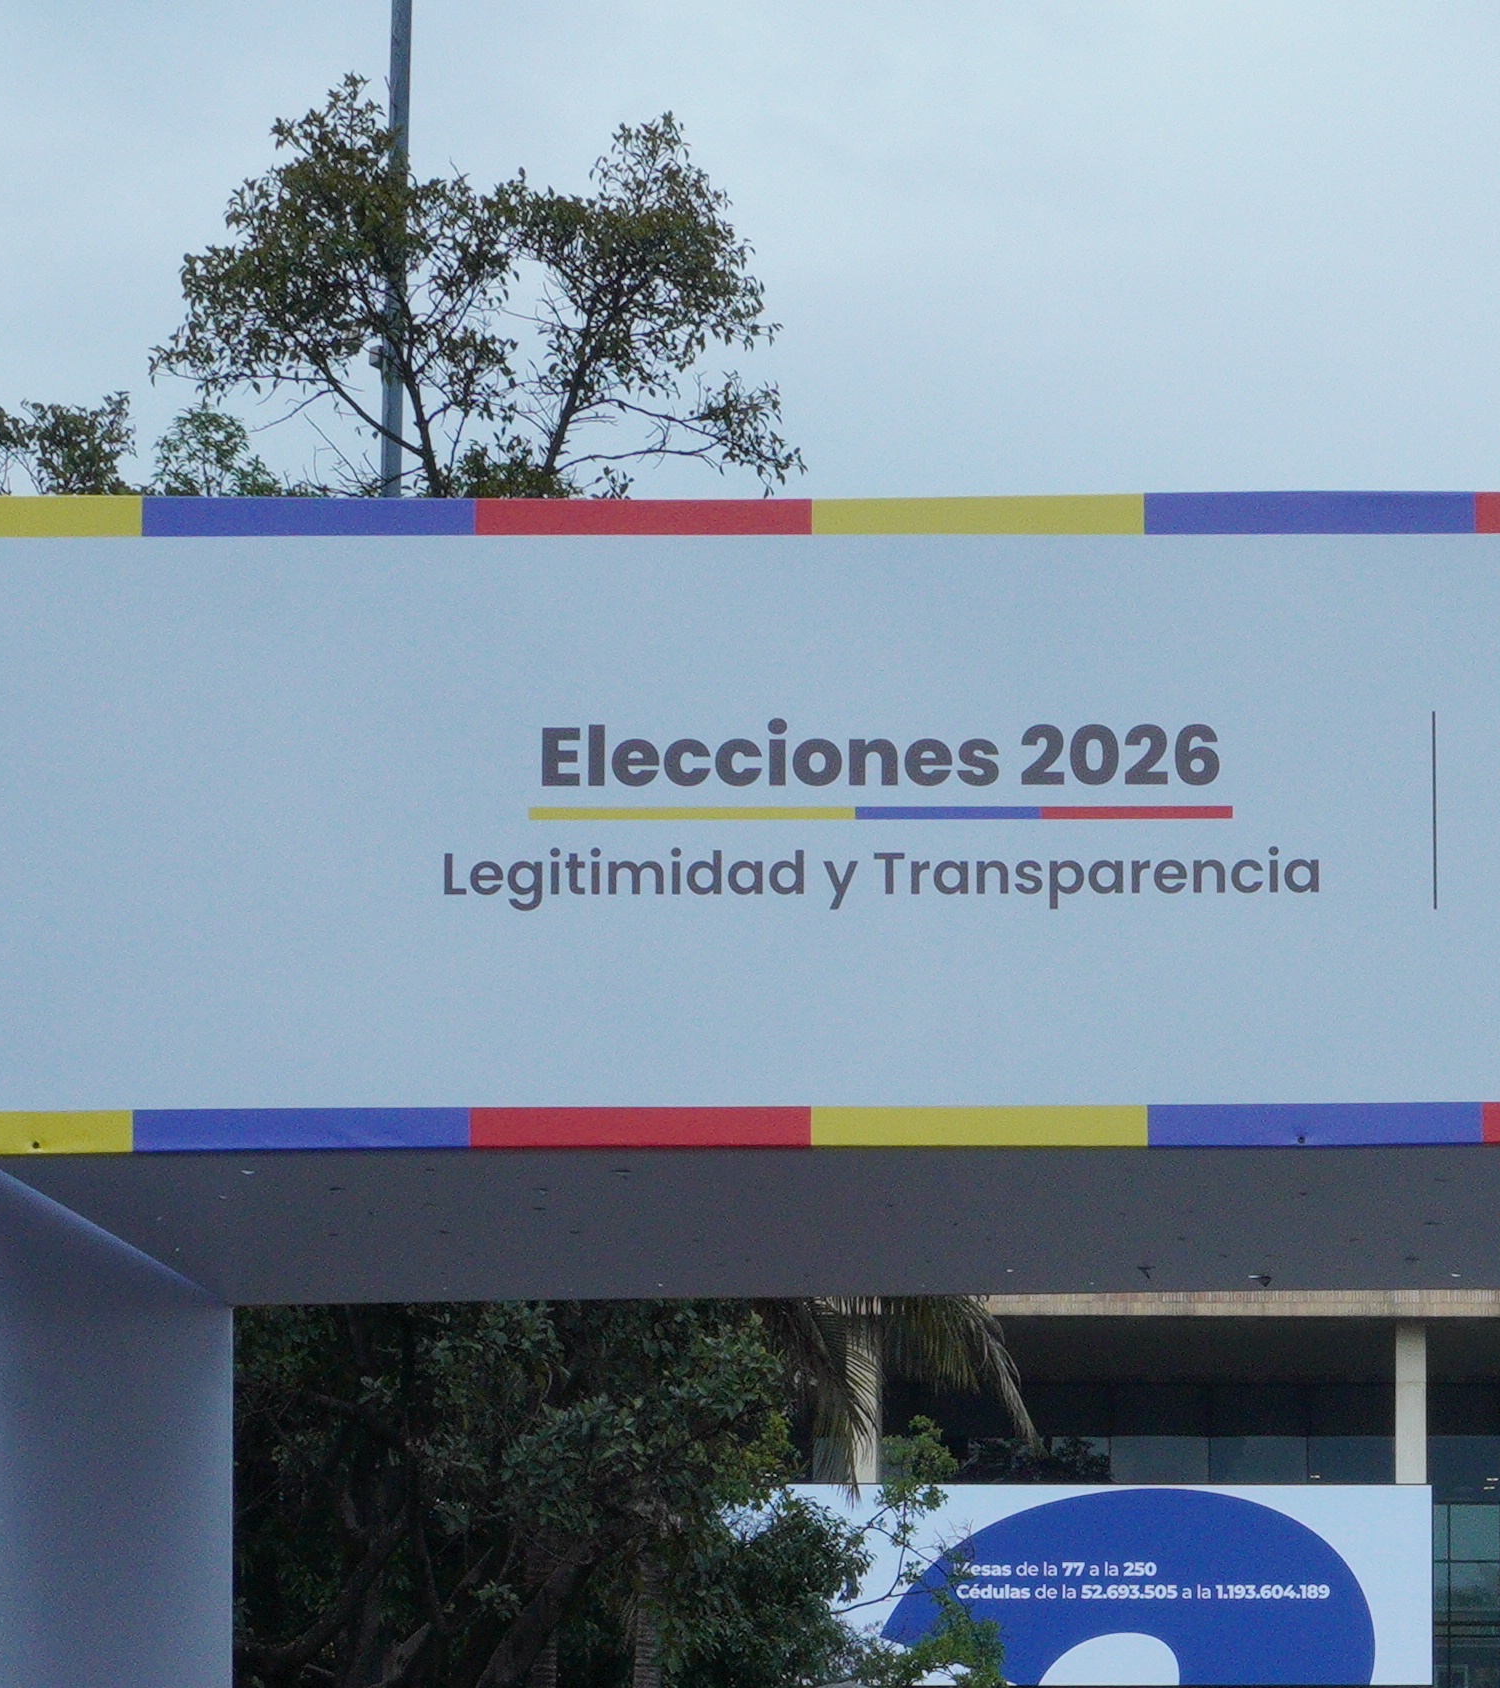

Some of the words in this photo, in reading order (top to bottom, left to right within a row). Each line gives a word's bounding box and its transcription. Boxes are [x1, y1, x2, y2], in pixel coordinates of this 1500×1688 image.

[541, 718, 1000, 788] Elecciones
[1021, 723, 1222, 787] 2026
[443, 848, 807, 911] Legitimidad
[824, 861, 858, 911] y
[874, 846, 1320, 911] Transparencia
[1015, 1561, 1040, 1577] de
[1043, 1561, 1058, 1577] la
[1062, 1562, 1084, 1577] 77
[1089, 1565, 1099, 1577] a
[1104, 1561, 1119, 1577] la
[1123, 1562, 1157, 1577] 250
[956, 1584, 1031, 1600] Cédulas
[1034, 1584, 1058, 1600] de
[1062, 1584, 1077, 1600] la
[1081, 1585, 1178, 1600] 52.693.505
[1182, 1588, 1192, 1600] a
[1197, 1584, 1212, 1600] la
[1215, 1585, 1330, 1600] 1.193.604.189
